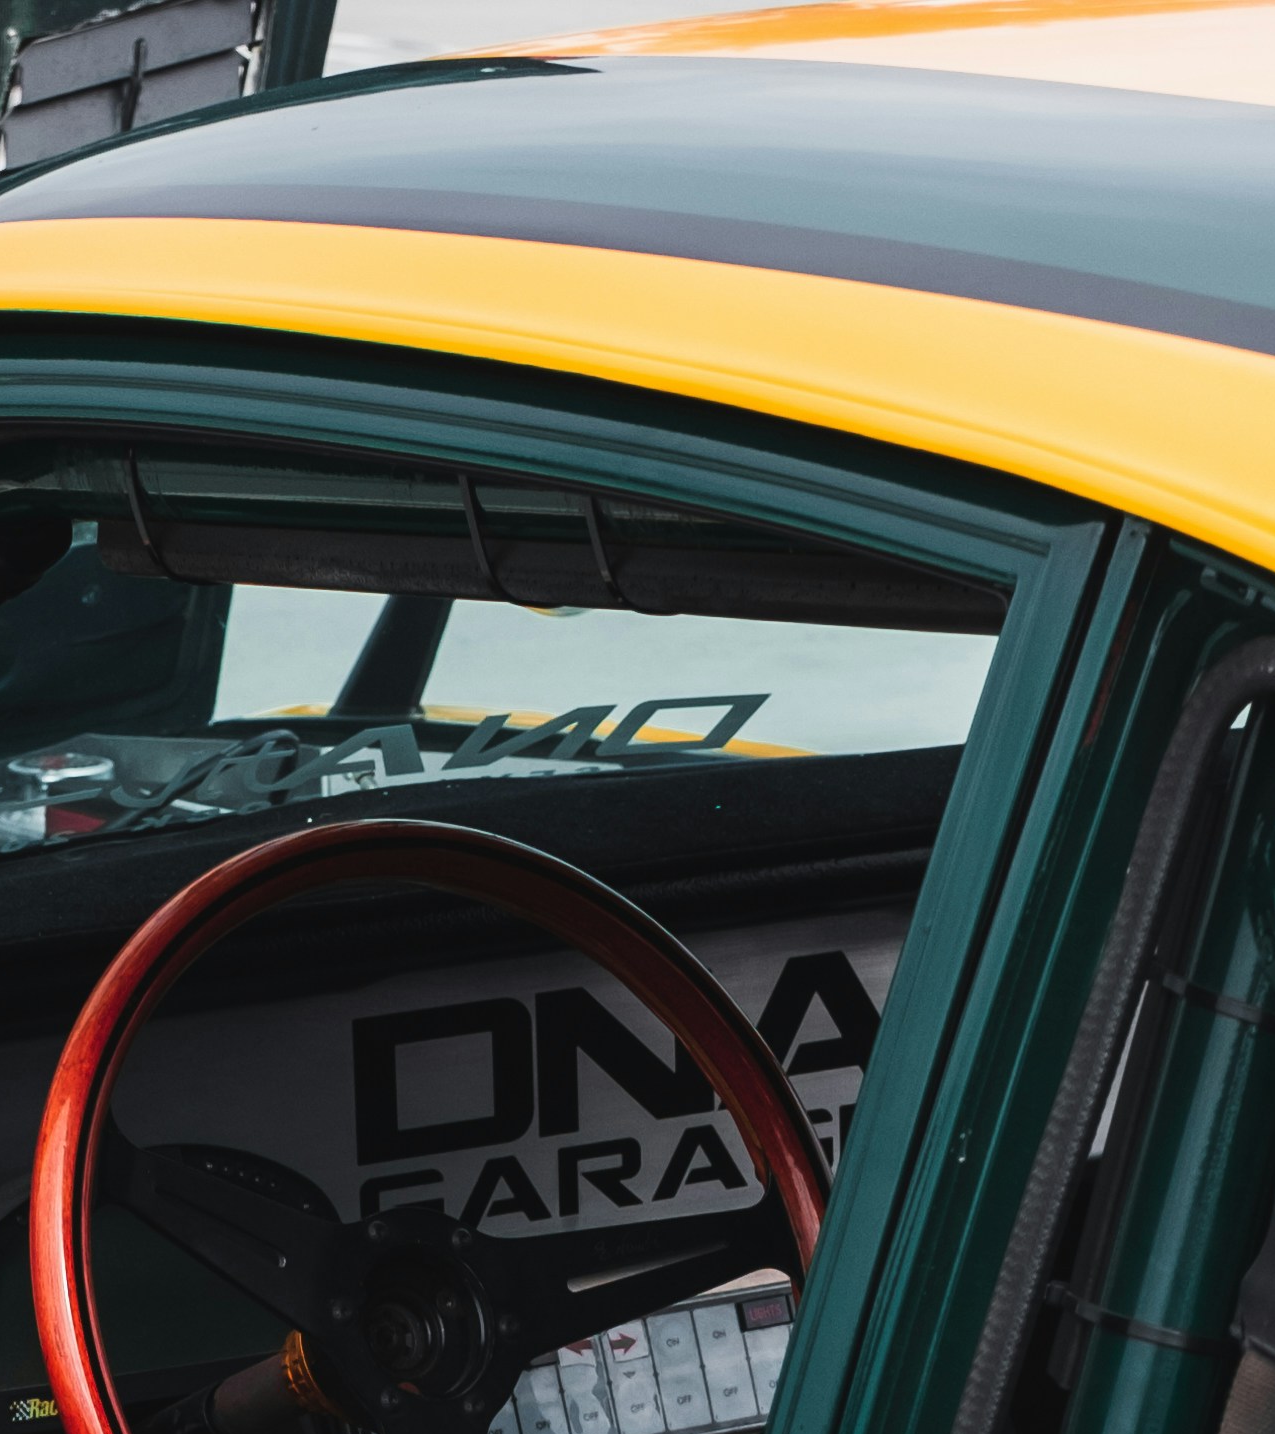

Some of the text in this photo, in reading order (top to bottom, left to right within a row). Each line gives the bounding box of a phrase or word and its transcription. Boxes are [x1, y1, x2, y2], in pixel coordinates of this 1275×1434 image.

[352, 950, 879, 1167] DNA
[359, 1102, 857, 1231] GARA
[676, 1394, 692, 1405] OFF
